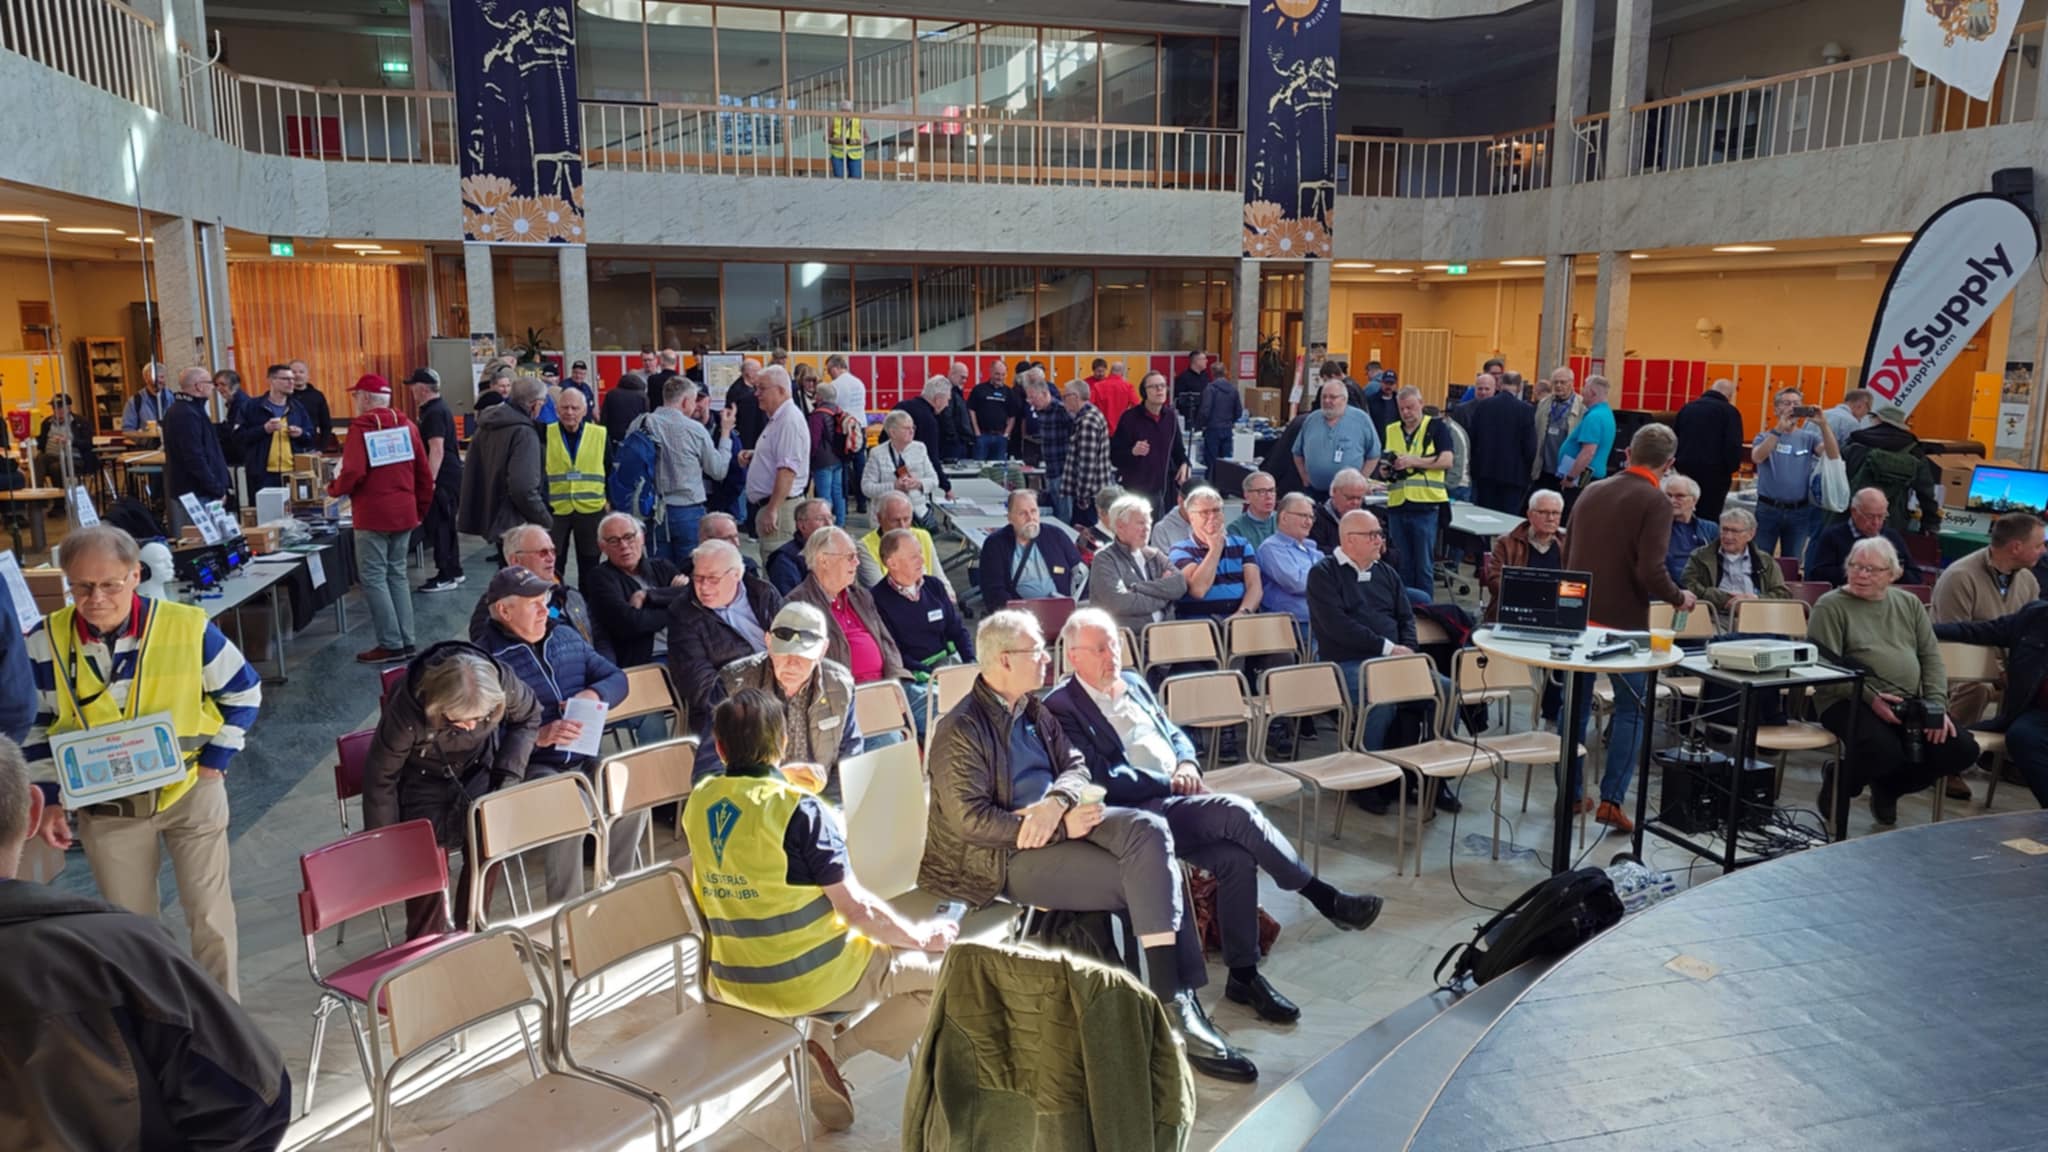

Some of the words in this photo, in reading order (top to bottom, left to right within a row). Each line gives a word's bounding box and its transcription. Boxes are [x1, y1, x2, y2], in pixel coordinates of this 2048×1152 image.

[1867, 242, 2014, 401] DXSupply
[1893, 333, 1957, 407] dxsupply.com
[1944, 511, 1977, 527] Supply
